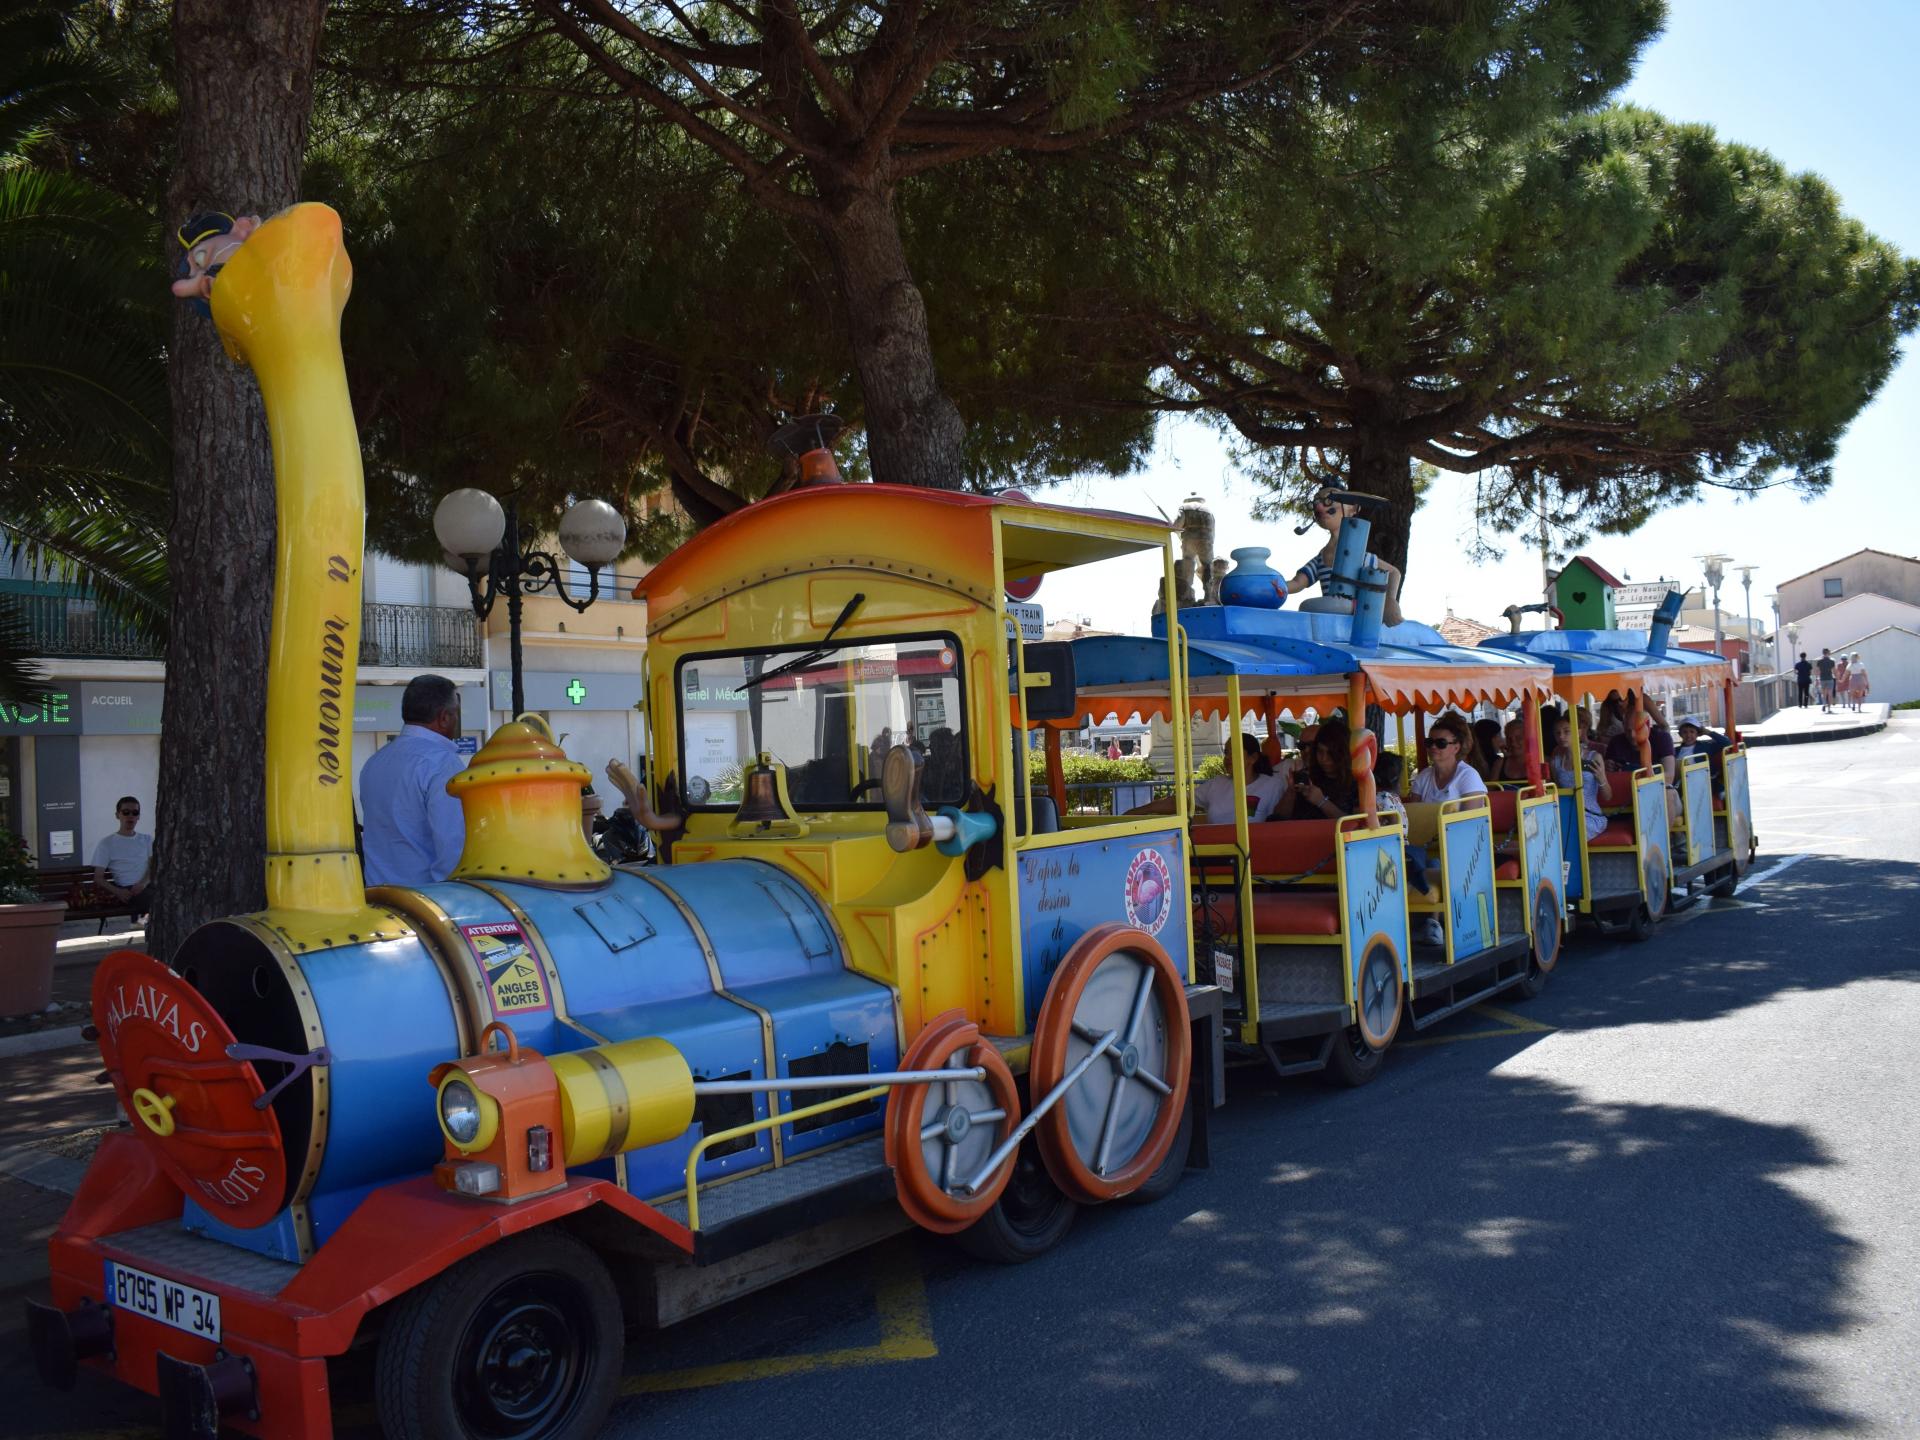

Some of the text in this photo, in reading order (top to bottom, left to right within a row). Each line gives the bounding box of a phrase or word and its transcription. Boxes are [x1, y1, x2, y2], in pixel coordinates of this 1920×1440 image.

[1022, 609, 1040, 619] TRAIN
[91, 696, 133, 705] ACCUEIL
[318, 615, 349, 786] ramoner
[1068, 852, 1080, 876] les
[1125, 849, 1171, 896] LUNA PARK
[1038, 888, 1070, 912] dessins
[468, 924, 518, 935] ATTENTION
[1051, 915, 1064, 940] de
[498, 981, 539, 995] ANGLES
[501, 993, 540, 1007] MORTS
[117, 1269, 215, 1335] 8795 WP 34
